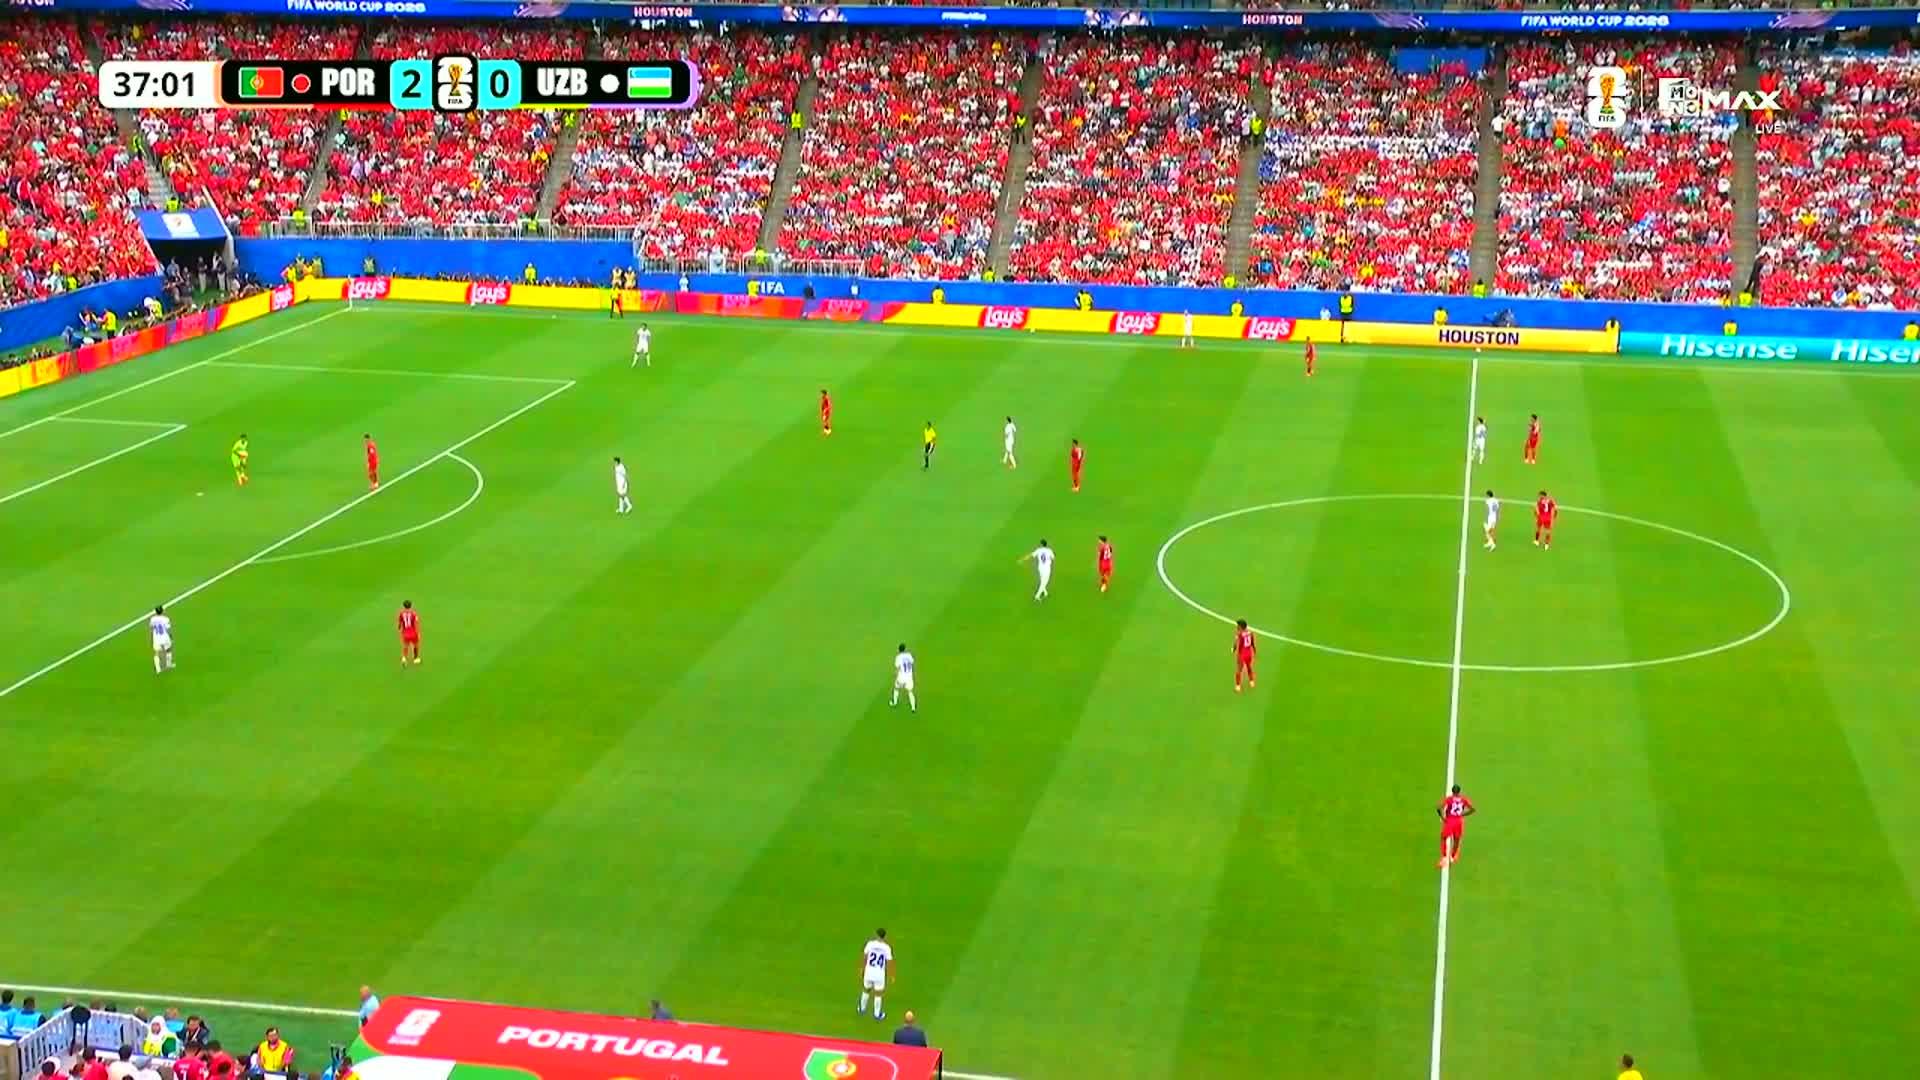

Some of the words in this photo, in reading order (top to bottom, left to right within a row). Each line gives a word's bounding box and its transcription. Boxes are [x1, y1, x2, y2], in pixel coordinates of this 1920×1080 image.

[287, 0, 313, 10] FIFA
[315, 1, 357, 12] WORLD
[359, 2, 383, 12] CUP
[384, 3, 426, 13] 2026
[633, 7, 693, 17] HOUSTON
[1242, 14, 1303, 25] HOUSTON
[1521, 16, 1548, 26] FIFA
[1550, 16, 1595, 26] WORLD
[1597, 16, 1622, 26] CUP
[1623, 16, 1670, 26] 2026
[347, 278, 388, 300] Lay's
[469, 284, 507, 306] Lay's
[757, 281, 785, 294] IFA
[984, 307, 1025, 328] Lay's
[1115, 313, 1156, 334] Lay's
[1248, 319, 1290, 341] Lay's
[1439, 329, 1520, 345] HOUSTON
[1660, 334, 1798, 359] Hisense
[869, 952, 884, 968] 24
[497, 1025, 729, 1066] PORTUGAL
